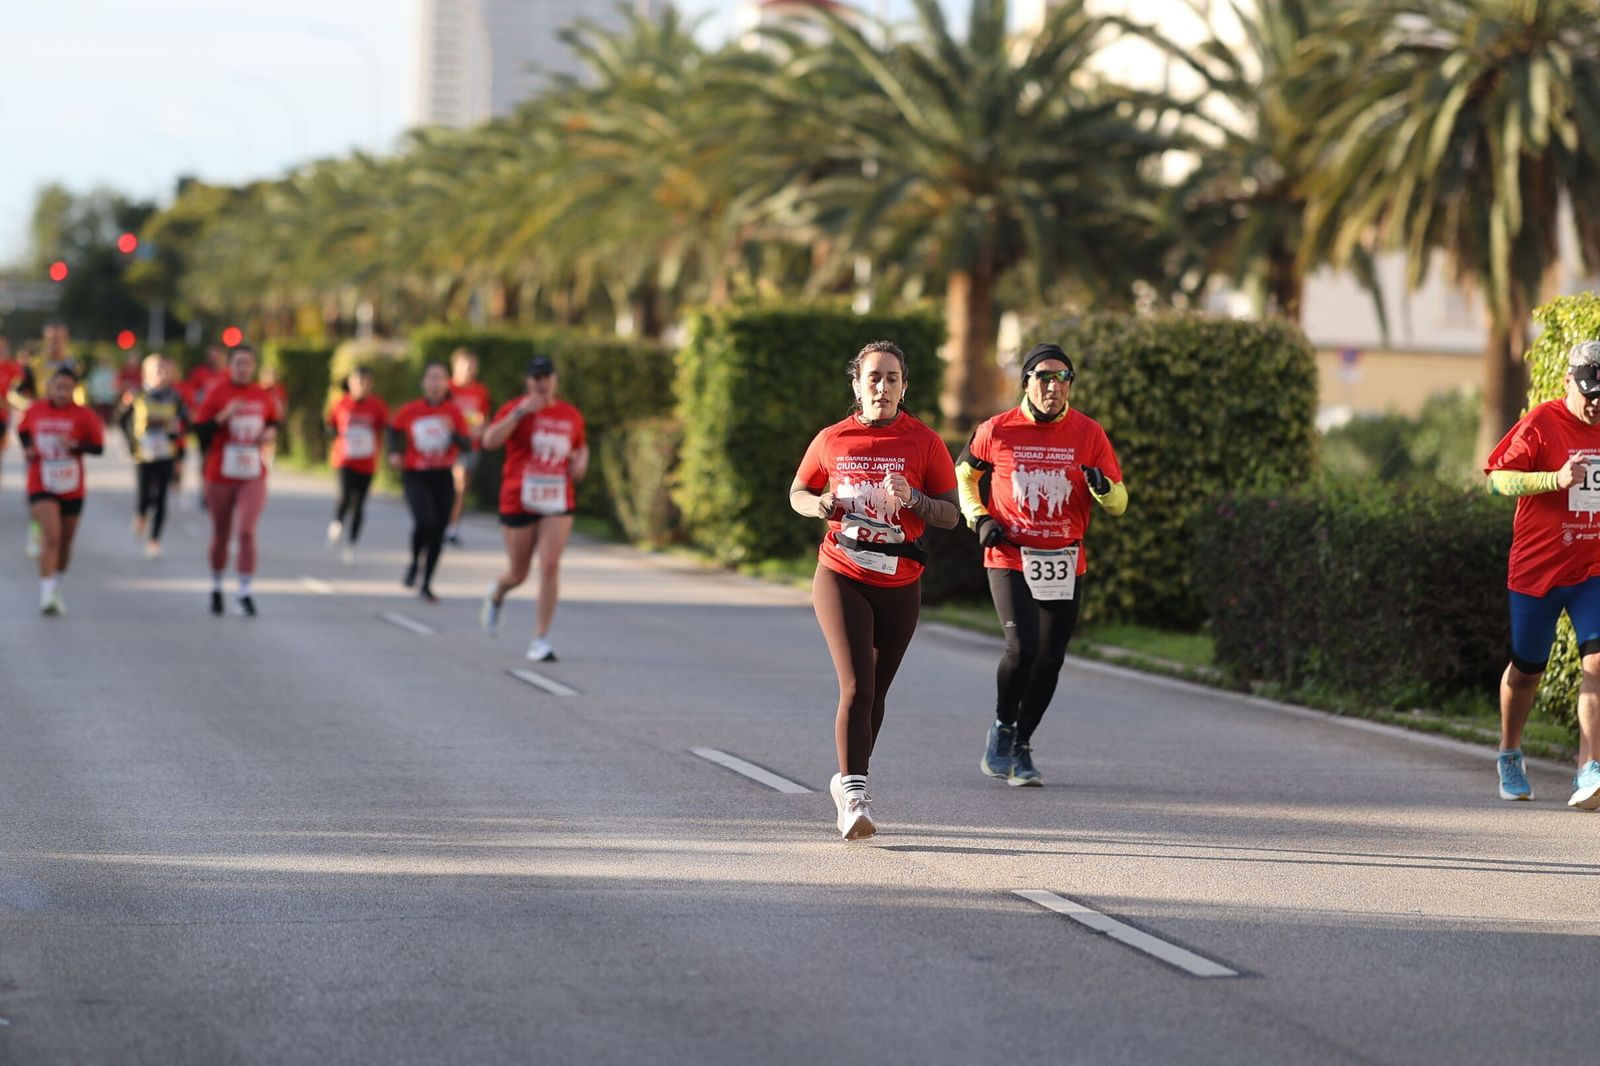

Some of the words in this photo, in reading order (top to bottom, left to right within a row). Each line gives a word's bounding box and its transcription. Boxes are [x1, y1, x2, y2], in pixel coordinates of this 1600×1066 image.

[1013, 451, 1044, 459] CIUDAD
[1045, 452, 1074, 461] JARDÍN
[836, 462, 869, 470] CIUDAD
[871, 462, 905, 471] JARDÍN
[1030, 560, 1069, 581] 333
